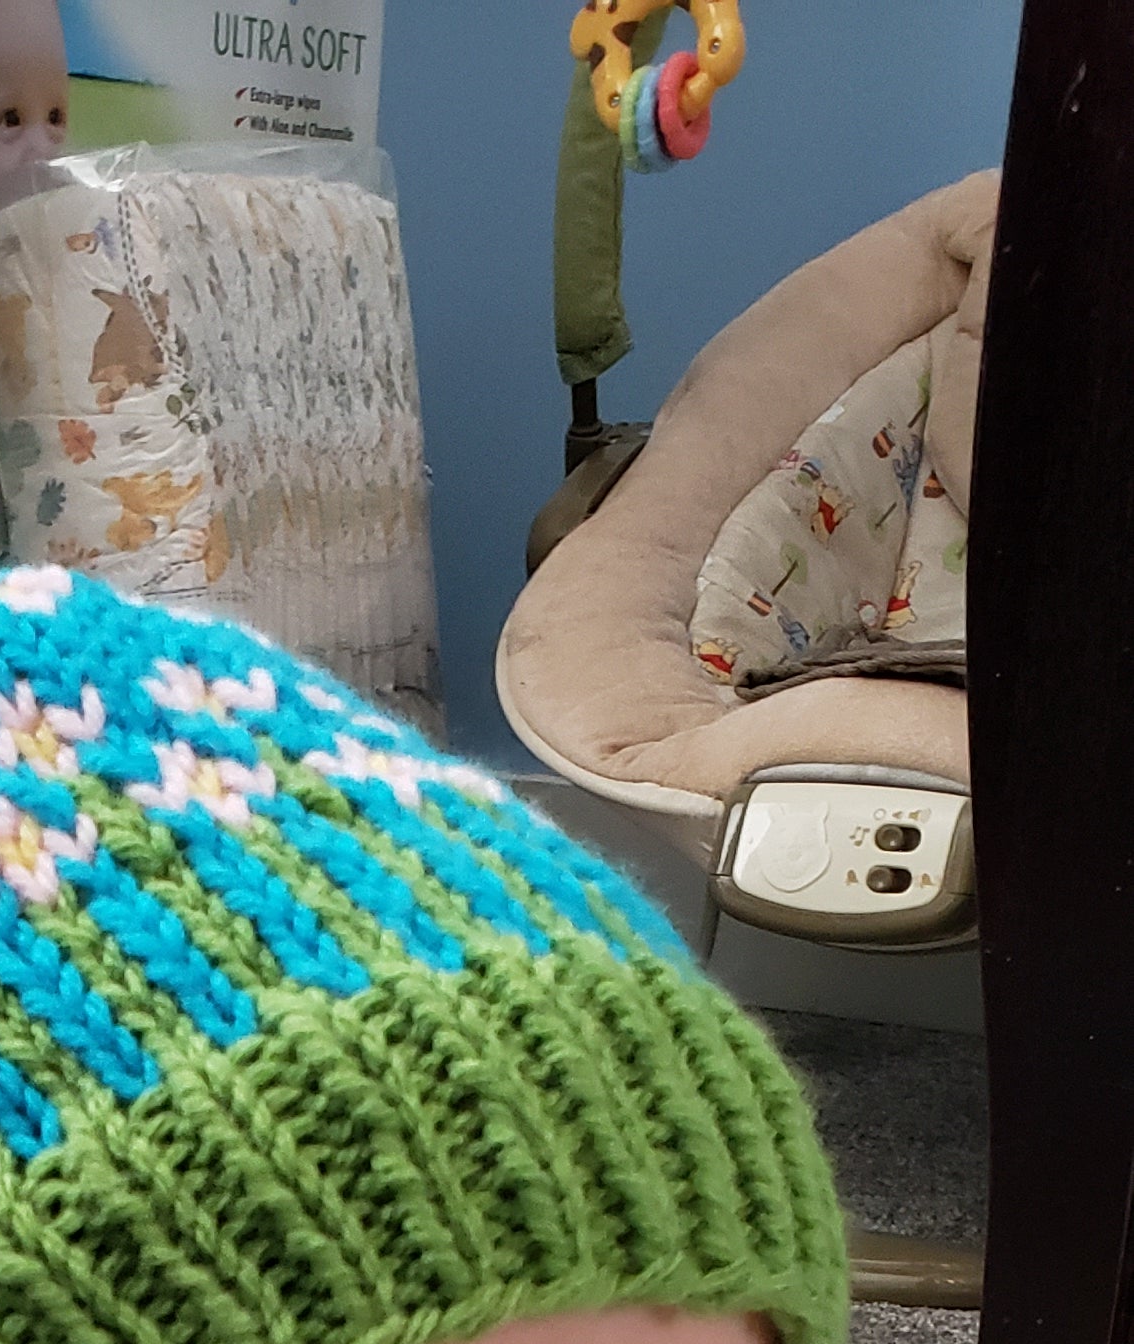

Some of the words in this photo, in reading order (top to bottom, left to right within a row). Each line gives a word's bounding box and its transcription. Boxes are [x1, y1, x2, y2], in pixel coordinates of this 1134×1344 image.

[214, 11, 293, 65] ULTRA
[301, 26, 367, 75] SOFT
[291, 121, 306, 136] and
